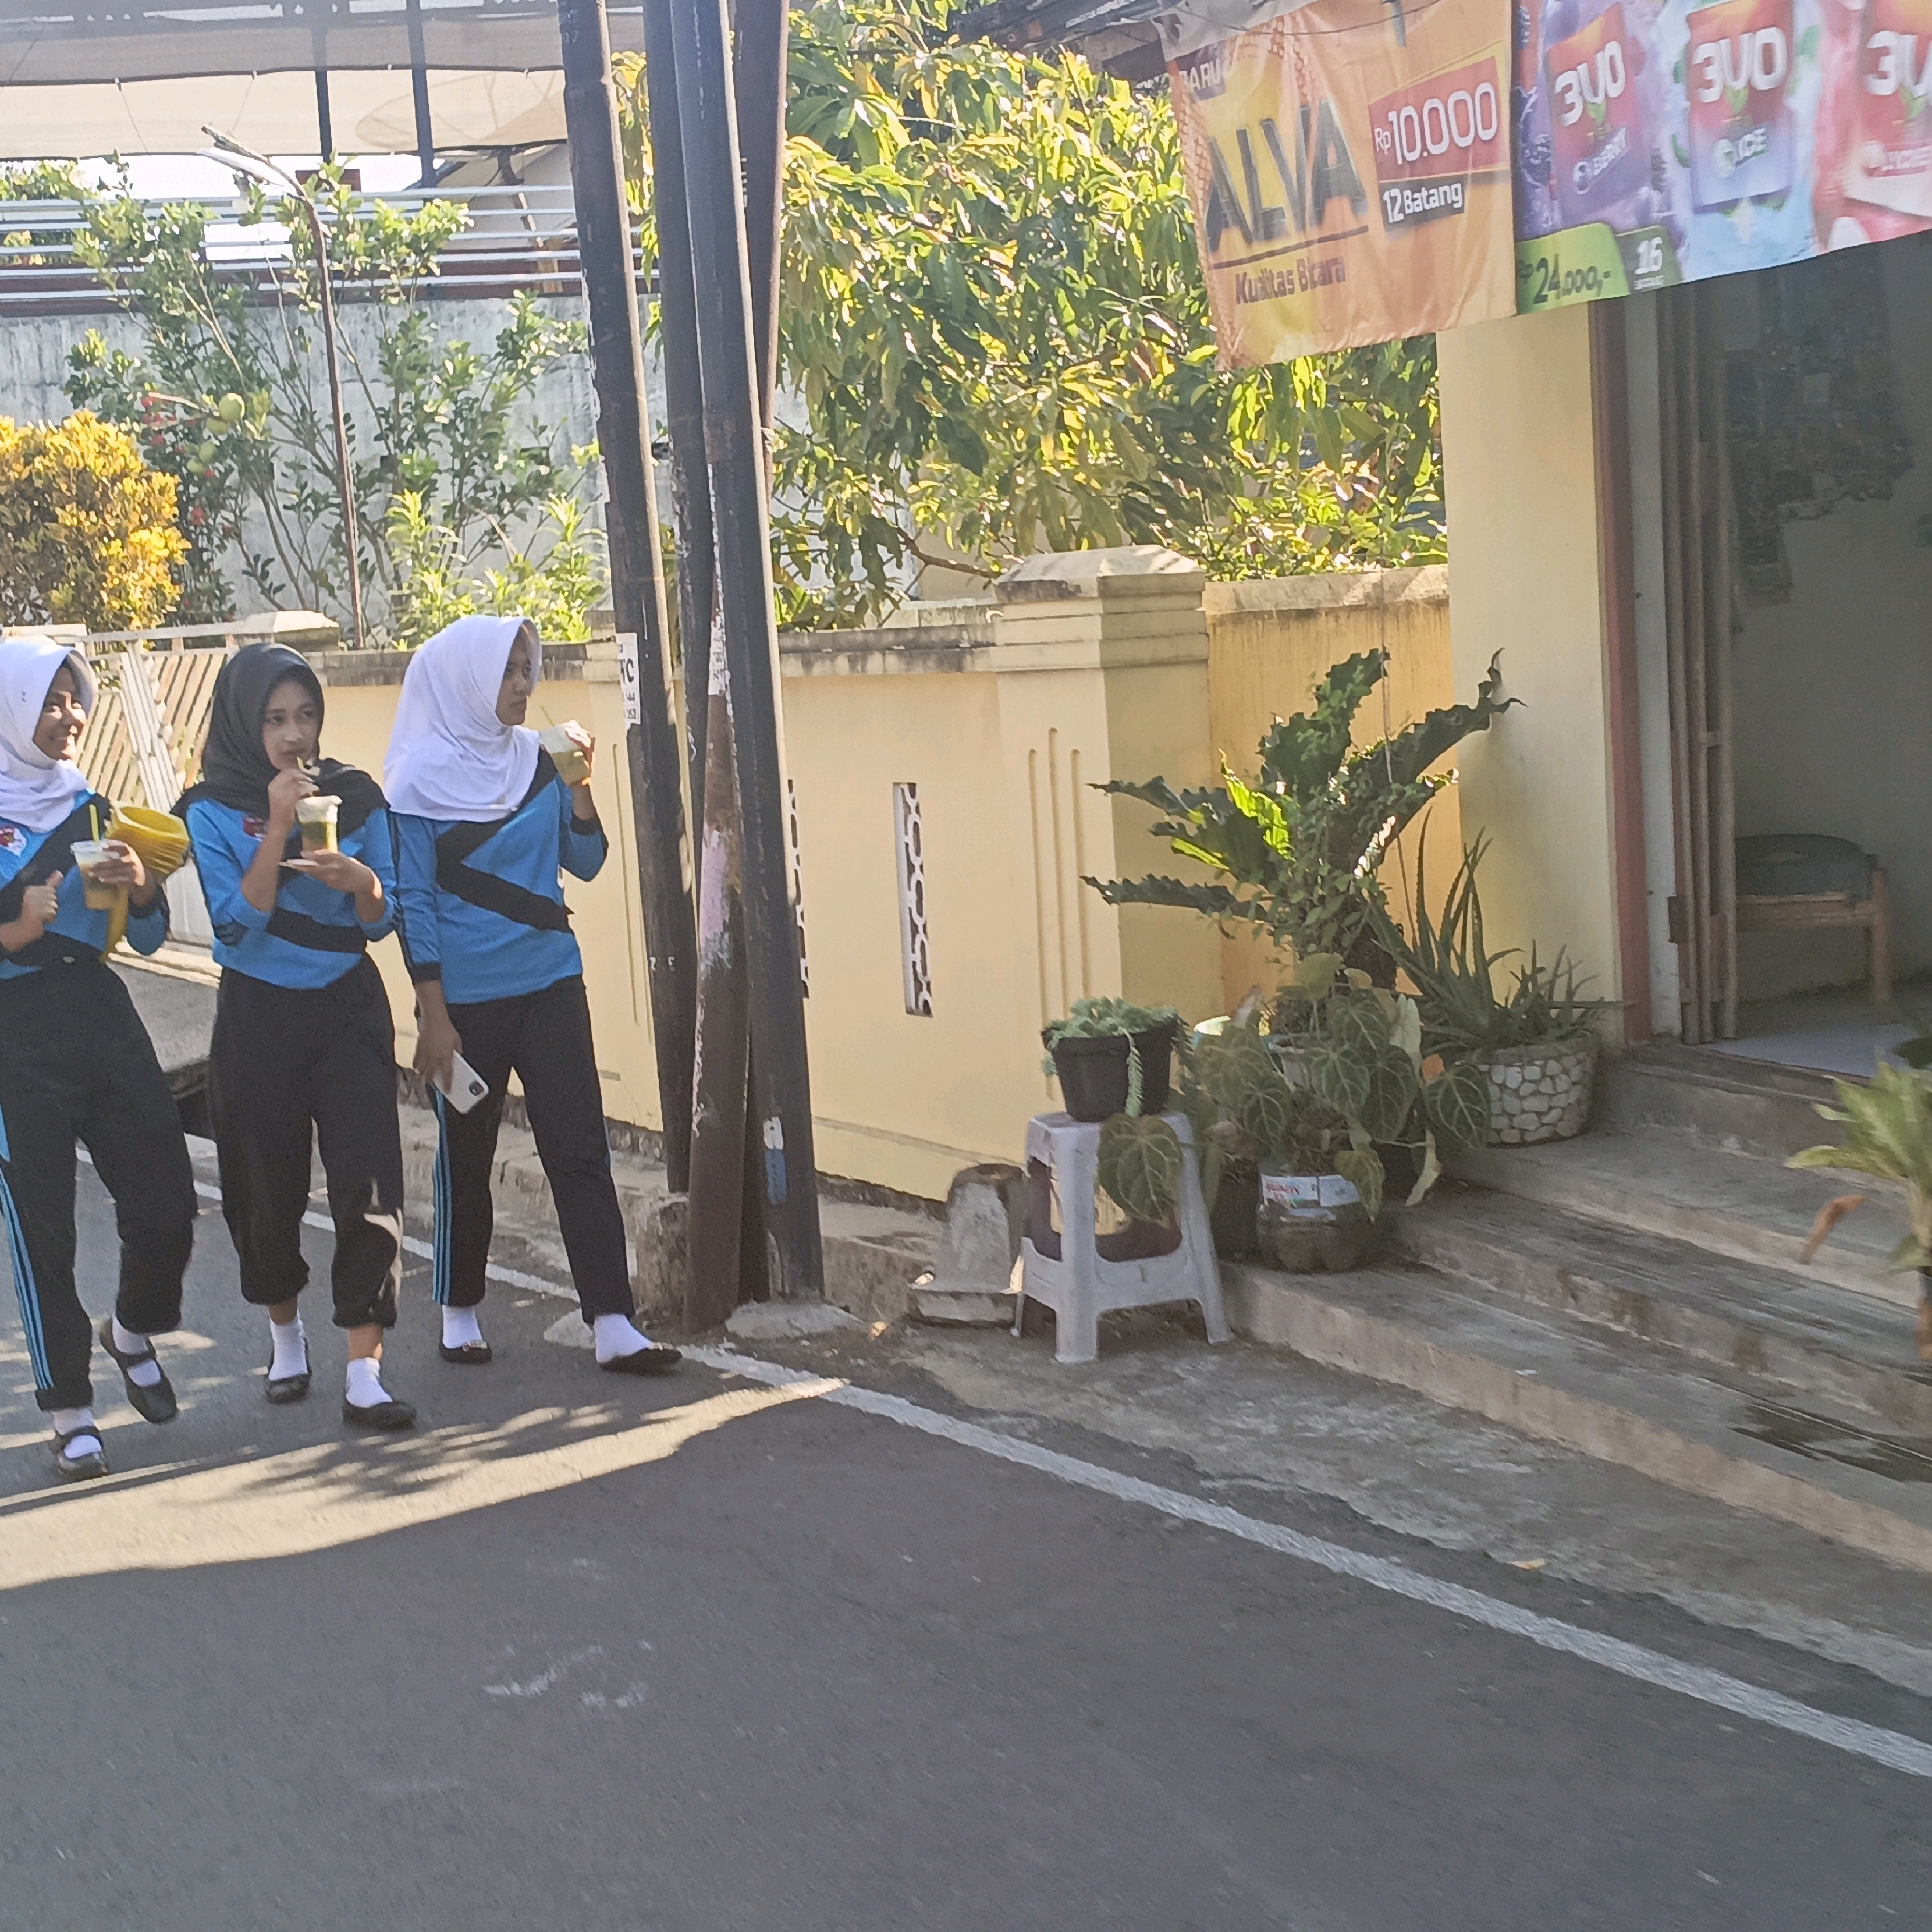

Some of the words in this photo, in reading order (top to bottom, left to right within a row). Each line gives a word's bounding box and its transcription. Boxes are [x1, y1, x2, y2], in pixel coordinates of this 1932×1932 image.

[1374, 128, 1392, 155] Rp
[1388, 82, 1498, 165] 10.000
[1205, 99, 1368, 252] ALVA
[1383, 188, 1404, 223] 12
[1404, 183, 1463, 214] Batang
